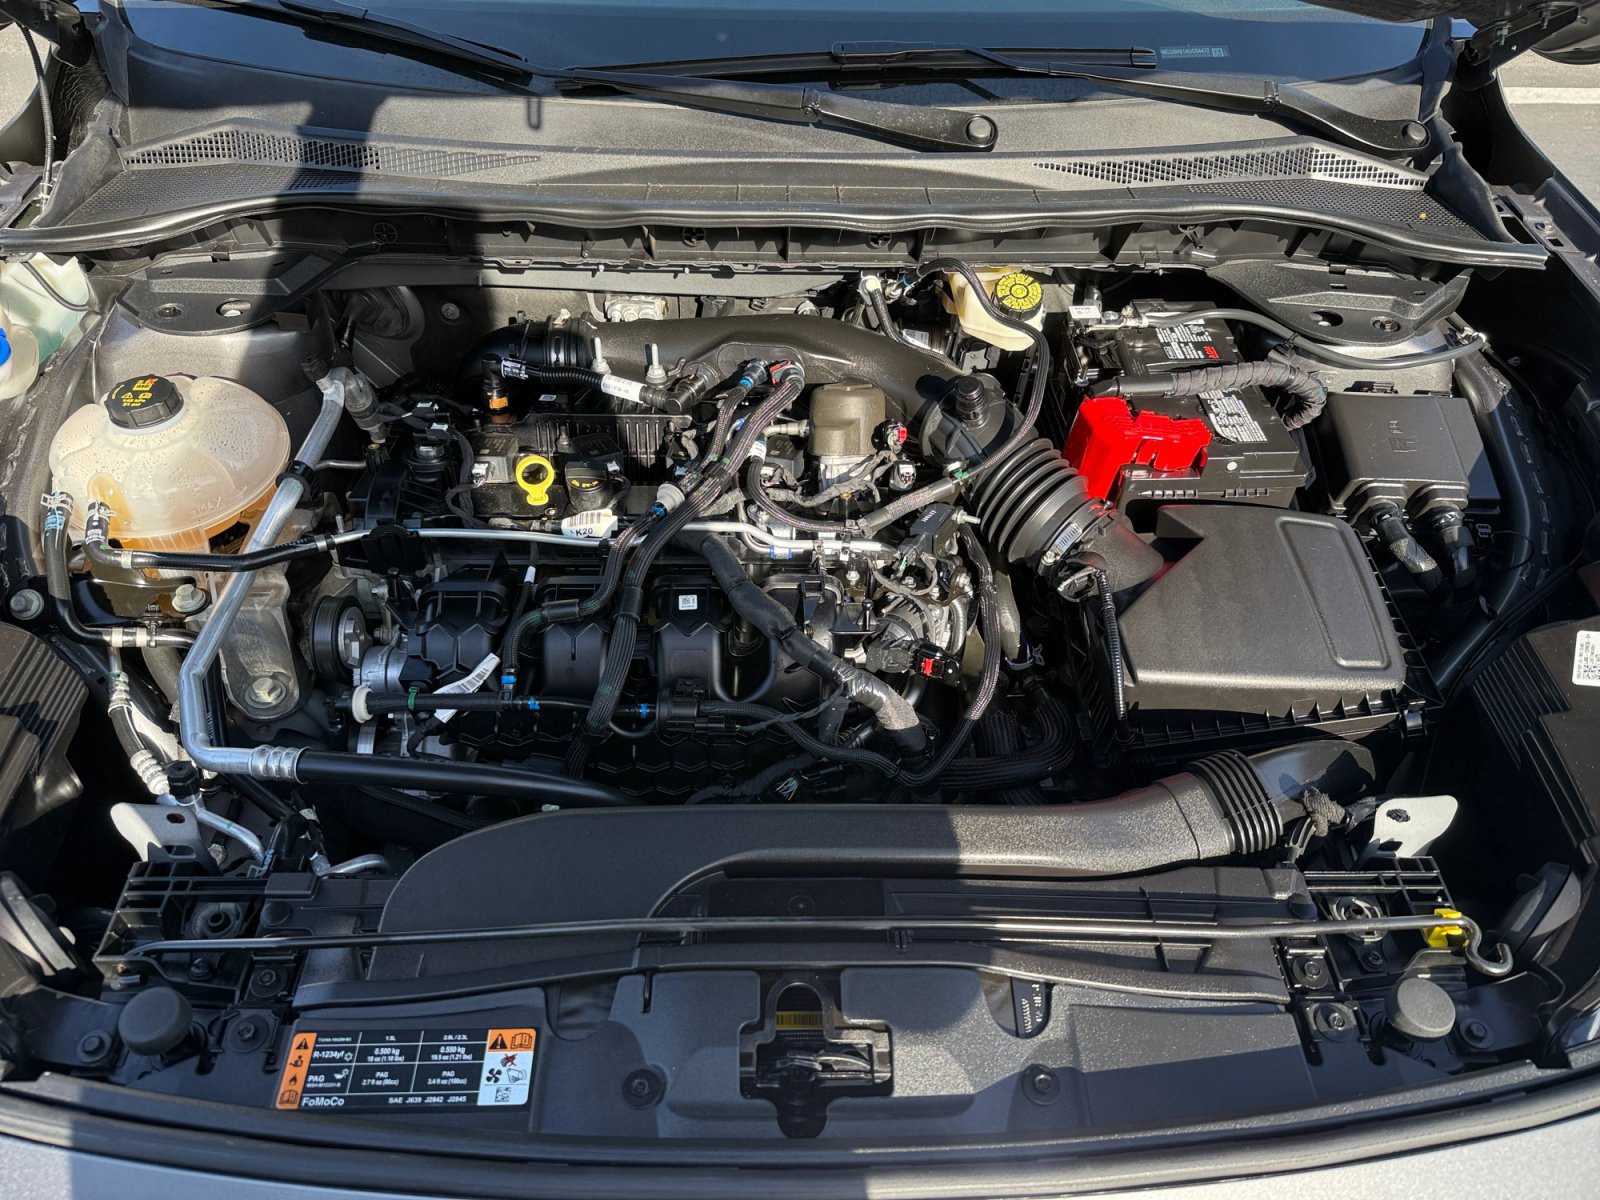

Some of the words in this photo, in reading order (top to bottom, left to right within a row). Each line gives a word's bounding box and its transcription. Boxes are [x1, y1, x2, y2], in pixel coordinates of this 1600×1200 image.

[576, 528, 593, 536] K20
[313, 1050, 345, 1059] R-1234yf
[374, 1047, 391, 1055] 0.500
[392, 1047, 400, 1056] kg
[457, 1046, 466, 1054] kg
[301, 1096, 345, 1106] FoMoCo
